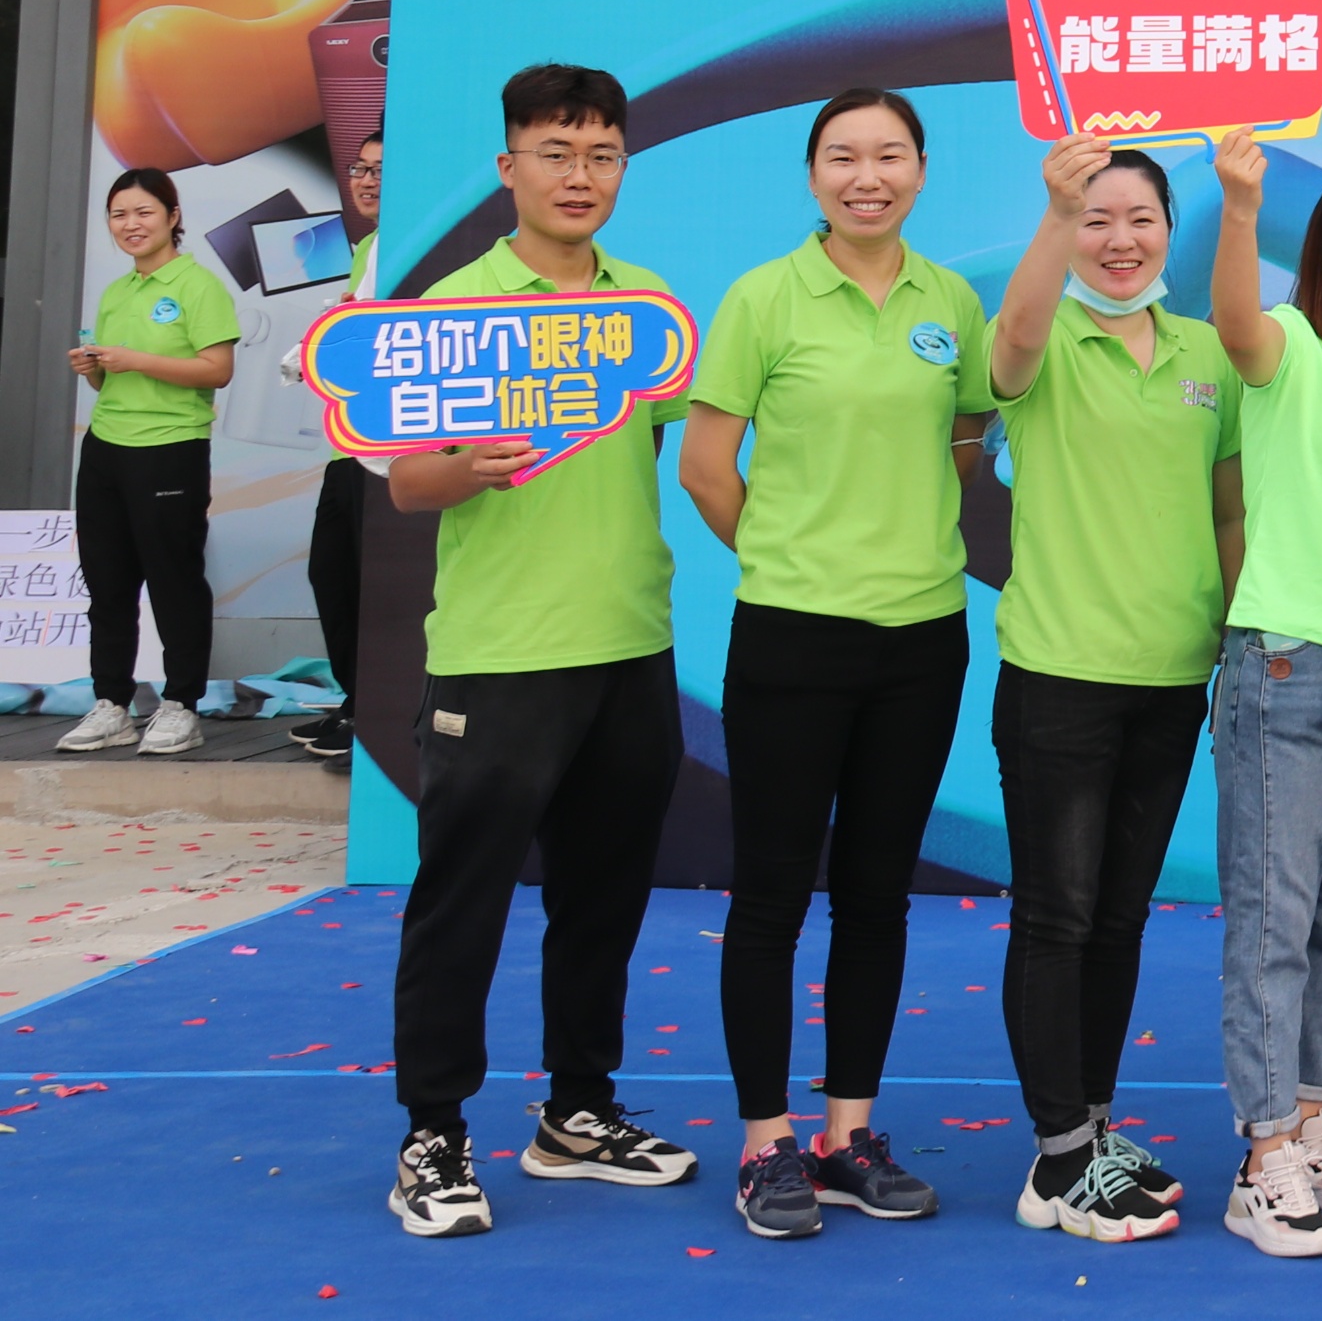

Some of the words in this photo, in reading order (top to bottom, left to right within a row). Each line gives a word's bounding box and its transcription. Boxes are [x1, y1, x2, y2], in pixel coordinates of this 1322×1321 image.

[1059, 13, 1320, 74] 能量满格
[372, 310, 634, 379] 给你个眼神
[390, 371, 601, 435] 自己体会
